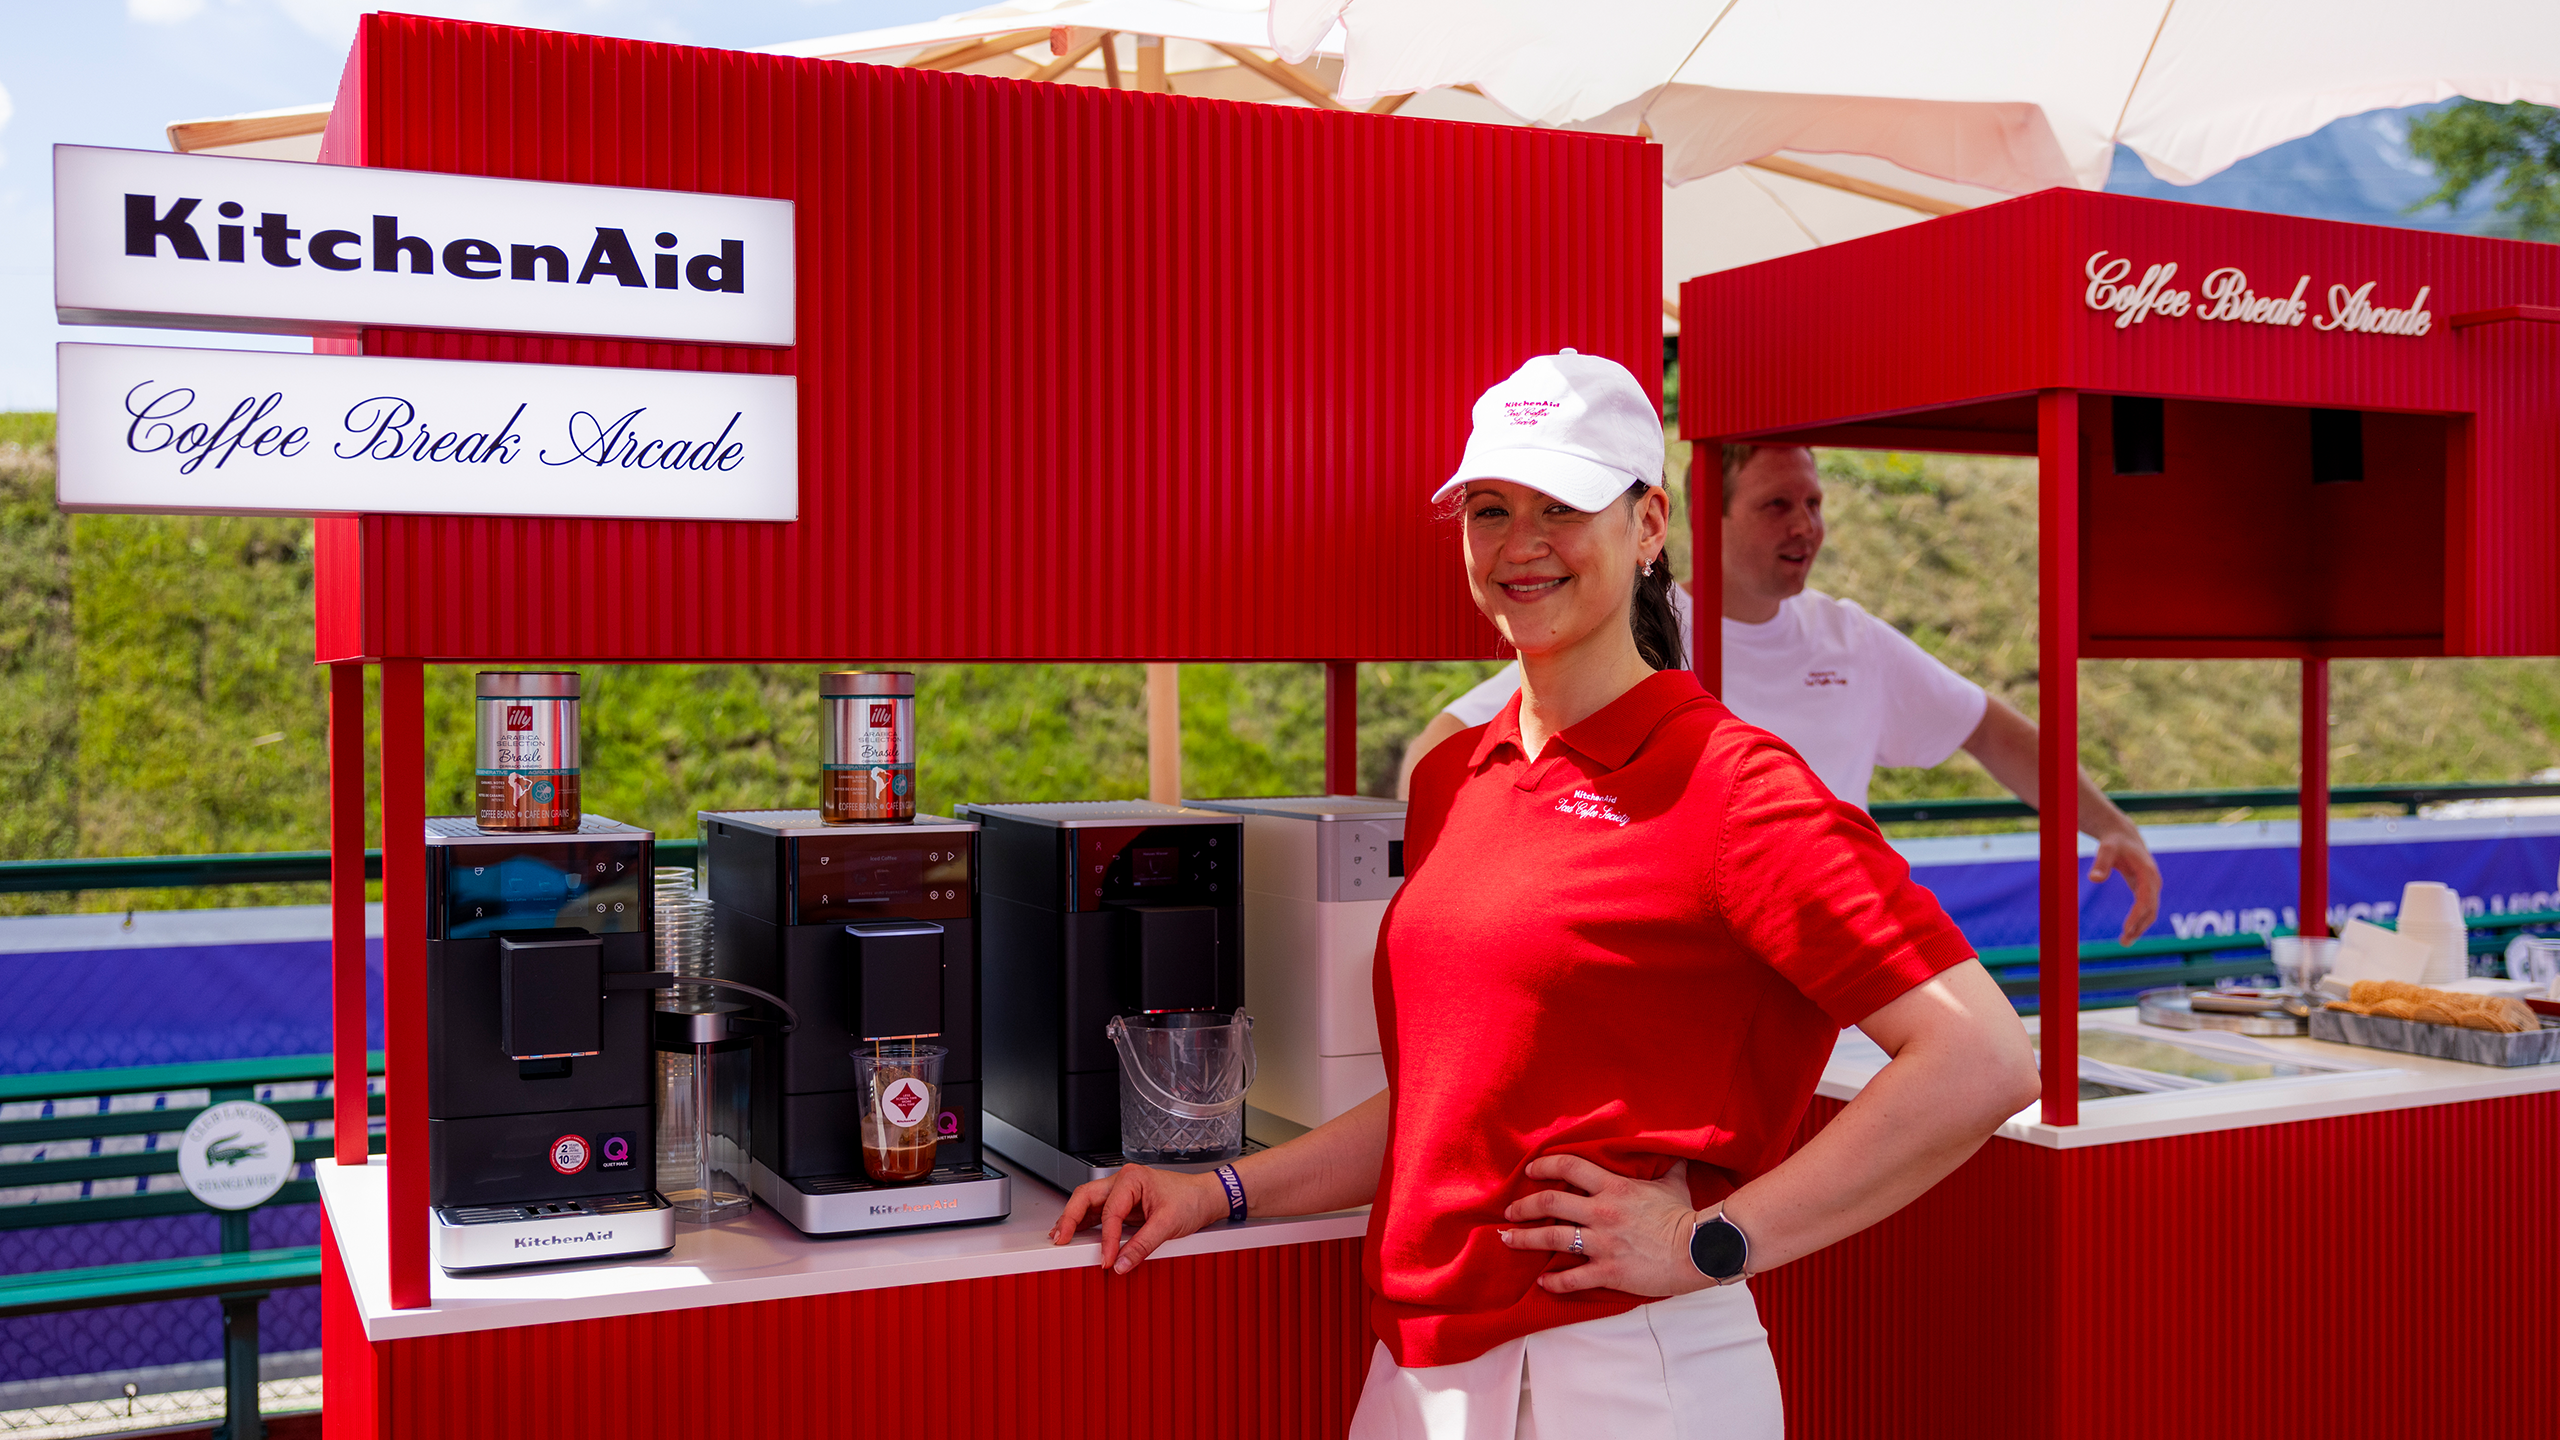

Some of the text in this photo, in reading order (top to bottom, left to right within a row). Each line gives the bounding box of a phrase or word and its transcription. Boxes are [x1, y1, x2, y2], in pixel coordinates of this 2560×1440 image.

[124, 193, 745, 295] KitchenAid
[2085, 250, 2432, 337] Coffee Break Arcade
[1504, 400, 1560, 408] KitchenAid
[125, 379, 745, 475] Coffee Break Arcade
[508, 709, 531, 729] illy
[871, 708, 891, 726] illy
[499, 748, 542, 763] Brasile
[861, 744, 900, 759] Brasile
[1573, 790, 1618, 804] KitchenAid
[480, 808, 569, 819] COFFEE BEANS CAFÉ EN GRAINS
[838, 802, 858, 811] COFFEE
[859, 802, 878, 811] BEANS
[886, 800, 898, 810] CAFÉ
[1575, 800, 1599, 819] Coffee
[1599, 805, 1631, 827] Society
[561, 1144, 568, 1153] 2
[558, 1155, 570, 1165] 10
[870, 1199, 957, 1216] KitchenAid
[514, 1230, 614, 1249] KitchenAid
